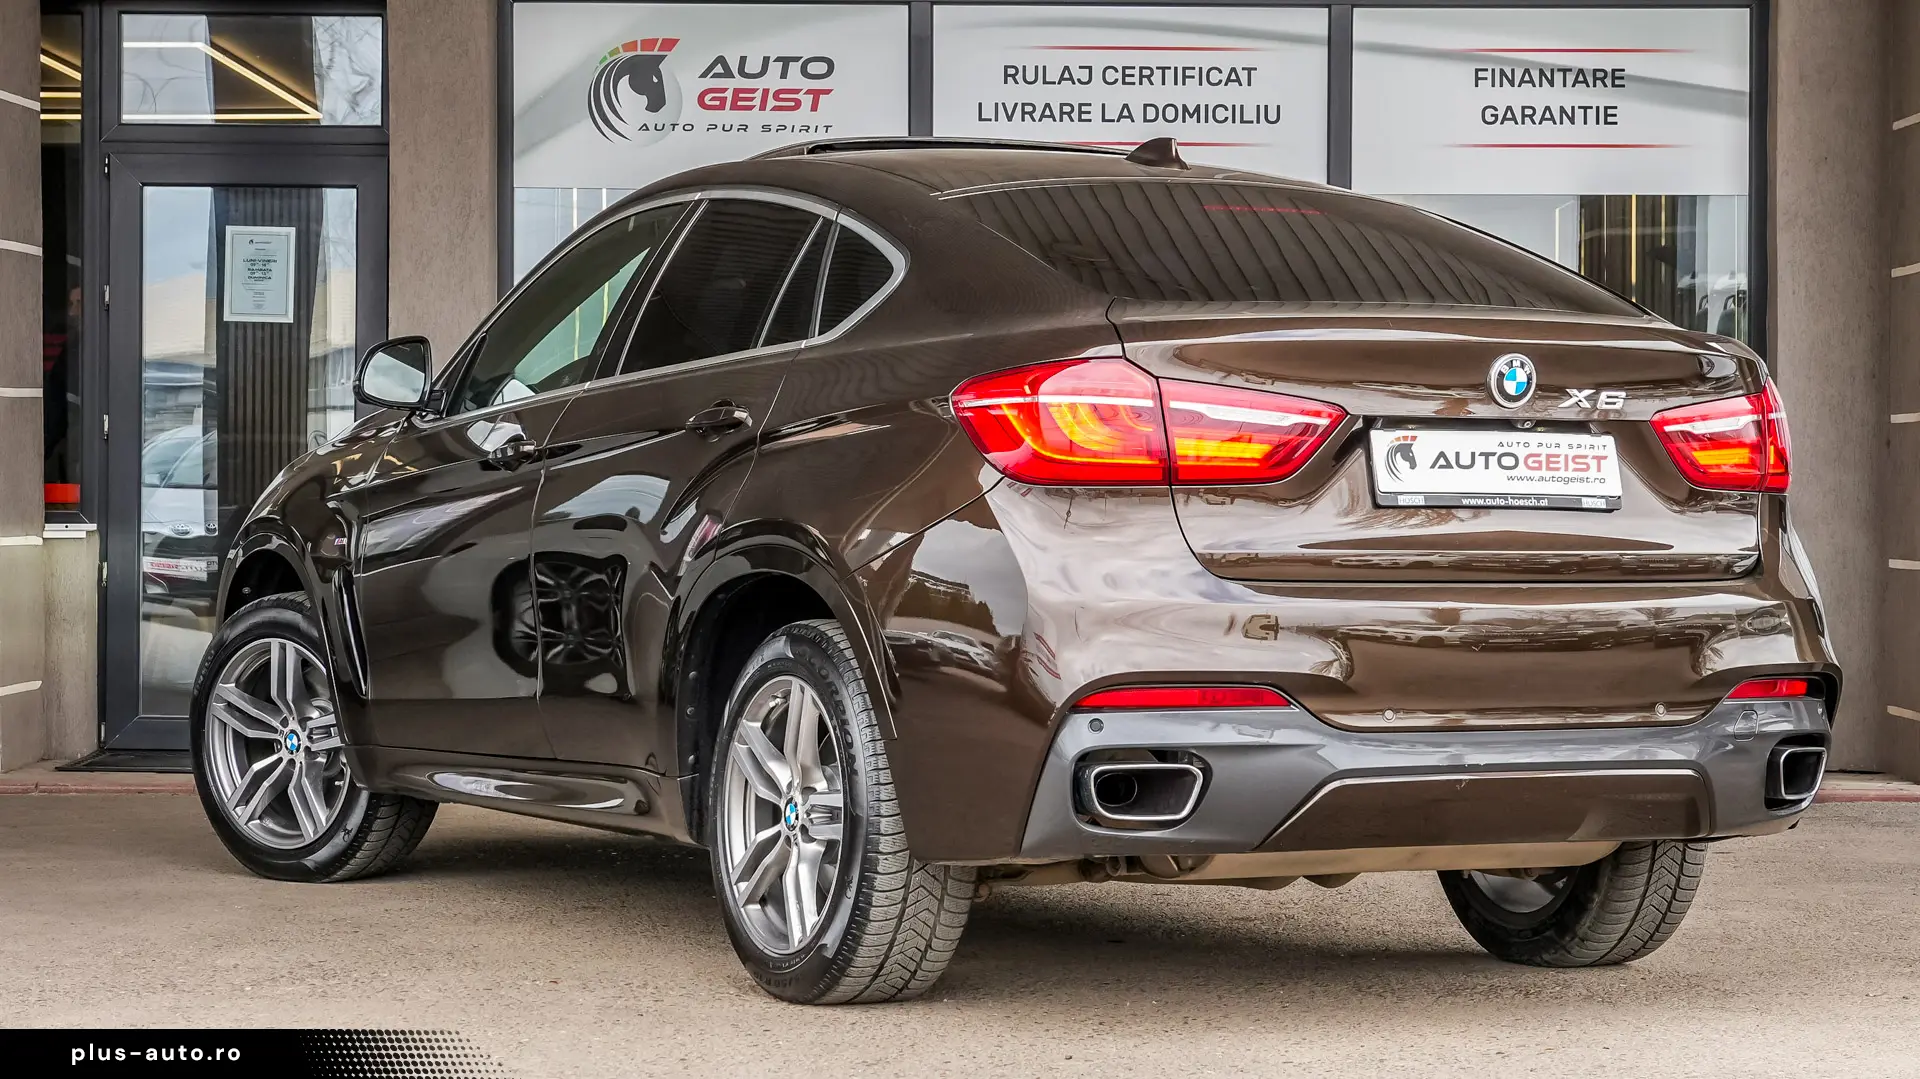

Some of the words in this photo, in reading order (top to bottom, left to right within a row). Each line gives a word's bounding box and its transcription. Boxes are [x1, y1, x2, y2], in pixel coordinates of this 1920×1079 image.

[698, 55, 835, 80] AUTO
[1003, 65, 1093, 86] RULAJ
[1101, 65, 1258, 87] CERTIFICAT
[1474, 68, 1626, 89] FINANTARE
[697, 88, 834, 112] GEIST
[977, 102, 1093, 123] LIVRARE
[1101, 103, 1135, 123] LA
[1142, 104, 1281, 125] DOMICILIU
[1481, 105, 1619, 126] GARANTIE
[638, 123, 695, 132] AUTO
[706, 123, 749, 133] PUR
[760, 124, 833, 134] SPIRIT
[1500, 359, 1532, 375] BMW
[1557, 388, 1627, 410] X6
[1567, 443, 1608, 451] SPIRIT
[1506, 474, 1606, 485] www.autogeist.ro
[1461, 496, 1549, 506] www.auto-hoesch.at
